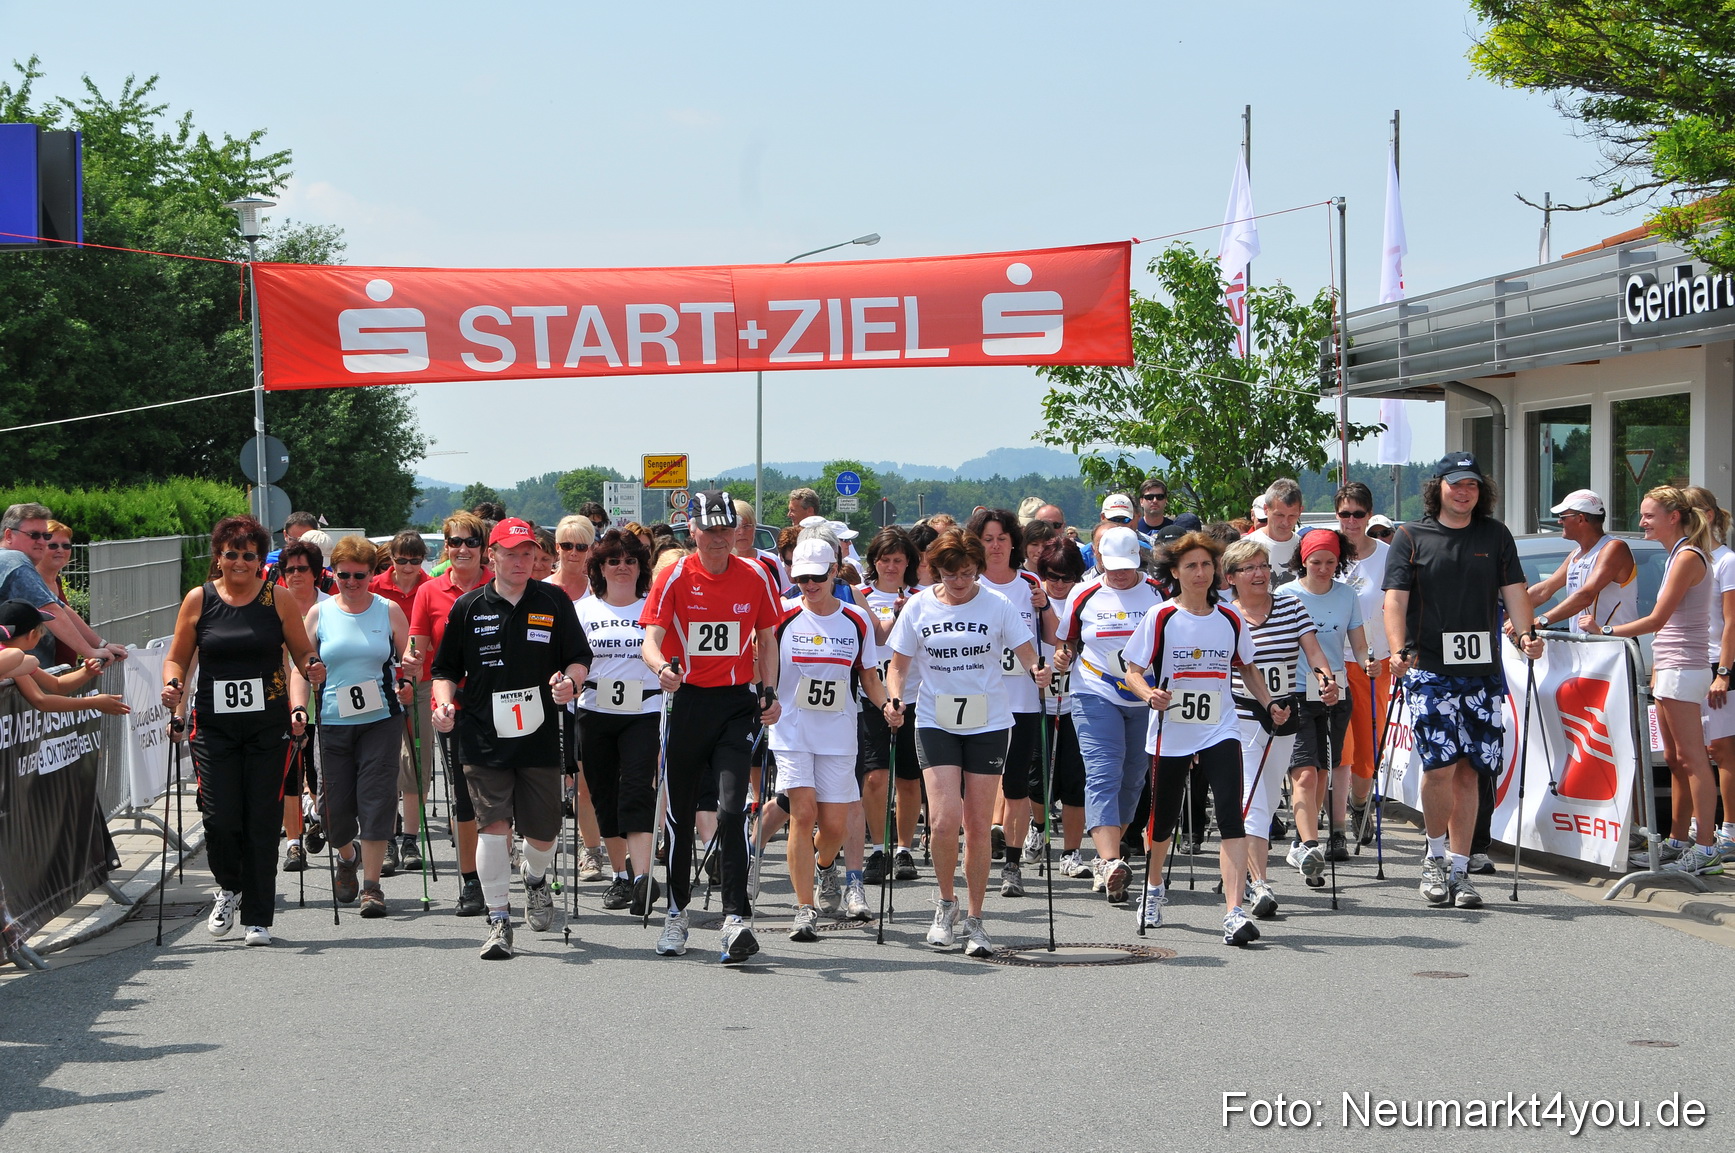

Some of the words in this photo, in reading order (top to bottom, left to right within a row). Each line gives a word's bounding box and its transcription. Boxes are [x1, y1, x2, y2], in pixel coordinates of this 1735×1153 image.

[698, 624, 728, 651] 28
[922, 622, 988, 638] BERGER
[962, 643, 991, 656] GIRLS
[999, 647, 1015, 671] 3
[1453, 634, 1480, 660] 30
[225, 681, 253, 708] 93
[350, 686, 366, 710] 8
[612, 680, 625, 706] 3
[808, 679, 836, 706] 55
[511, 704, 523, 730] 1
[954, 698, 967, 724] 7
[1182, 692, 1211, 721] 56
[14, 708, 42, 745] NEUE
[46, 736, 80, 766] OKTOBER
[79, 733, 94, 755] BEI
[1552, 812, 1621, 842] SEAT
